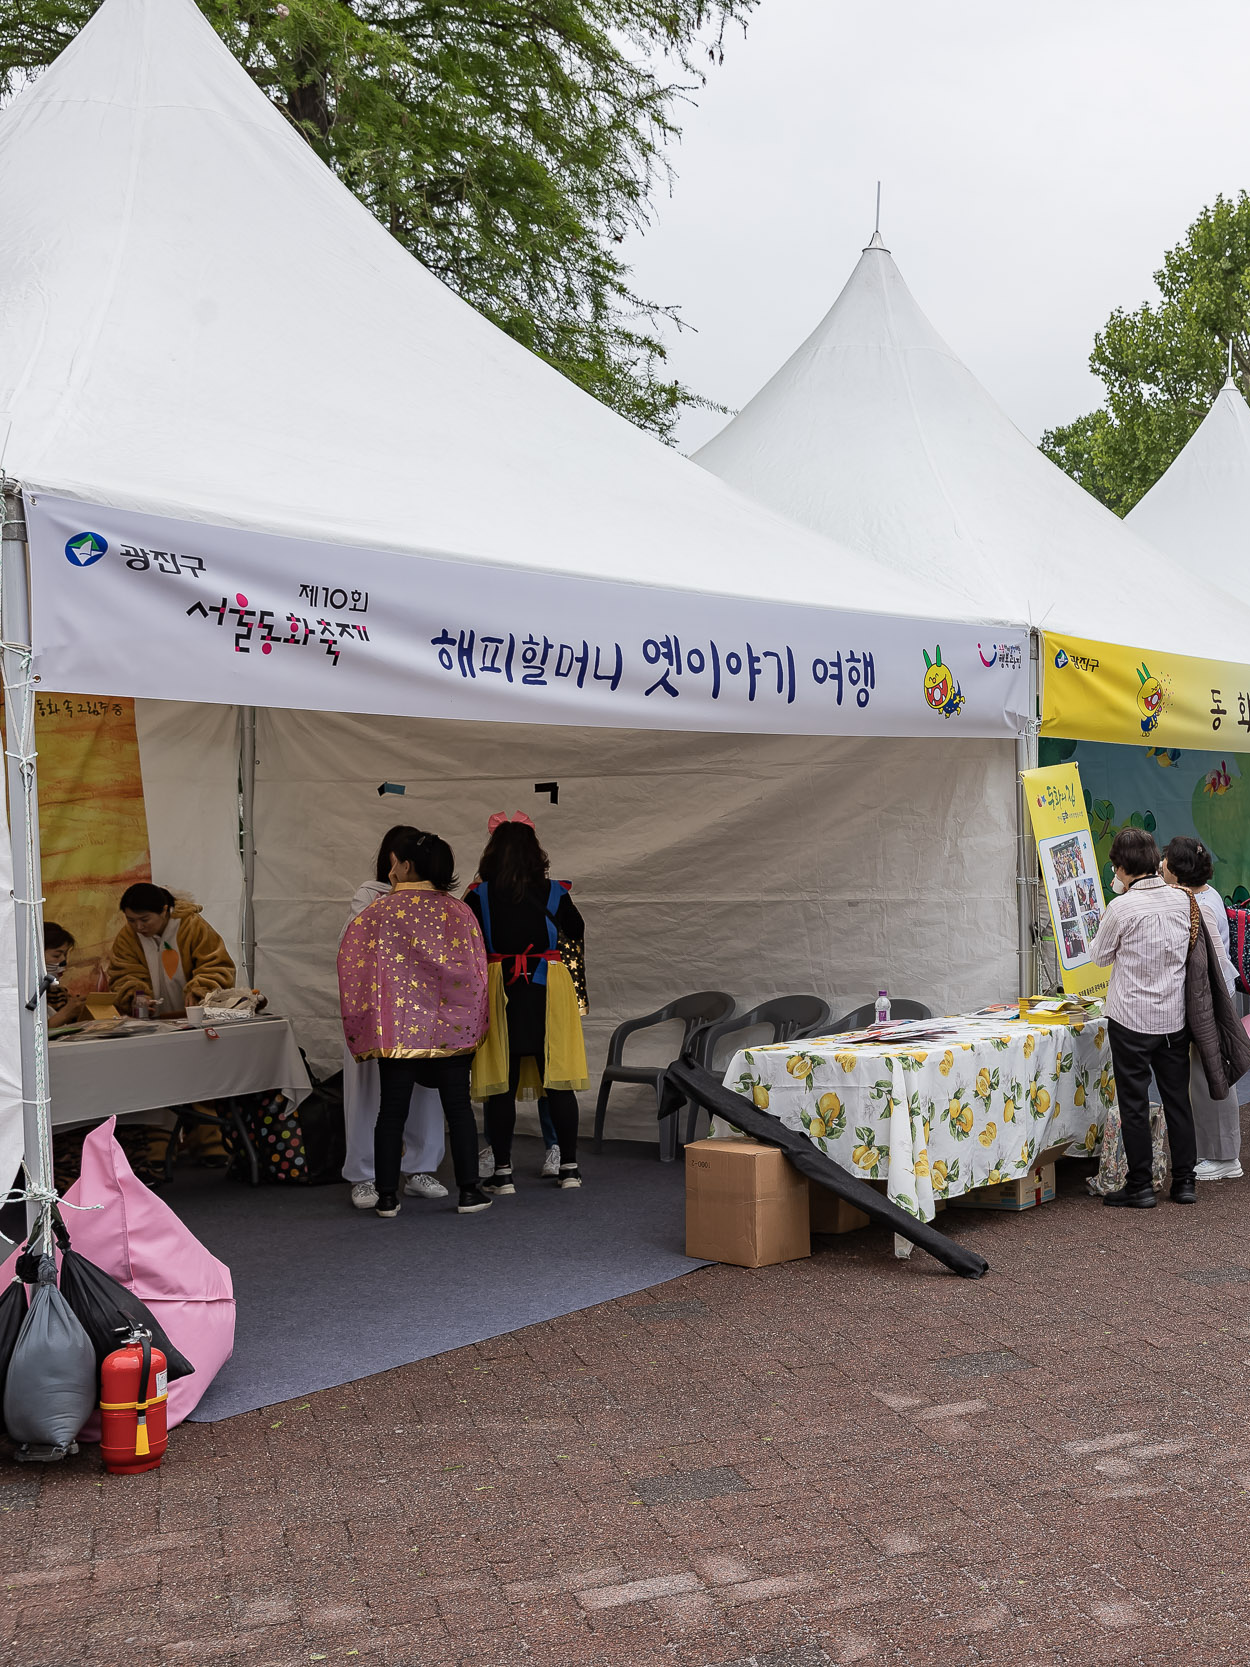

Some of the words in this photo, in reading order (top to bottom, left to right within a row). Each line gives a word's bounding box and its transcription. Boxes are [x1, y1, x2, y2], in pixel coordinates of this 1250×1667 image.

[119, 543, 207, 579] 광진구
[298, 583, 369, 613] 제10회
[185, 592, 370, 667] 서울동화축제
[430, 628, 624, 692] 해피할머니
[642, 634, 796, 704] 옛이야기
[812, 650, 876, 709] 여행
[1069, 654, 1100, 673] 광진구
